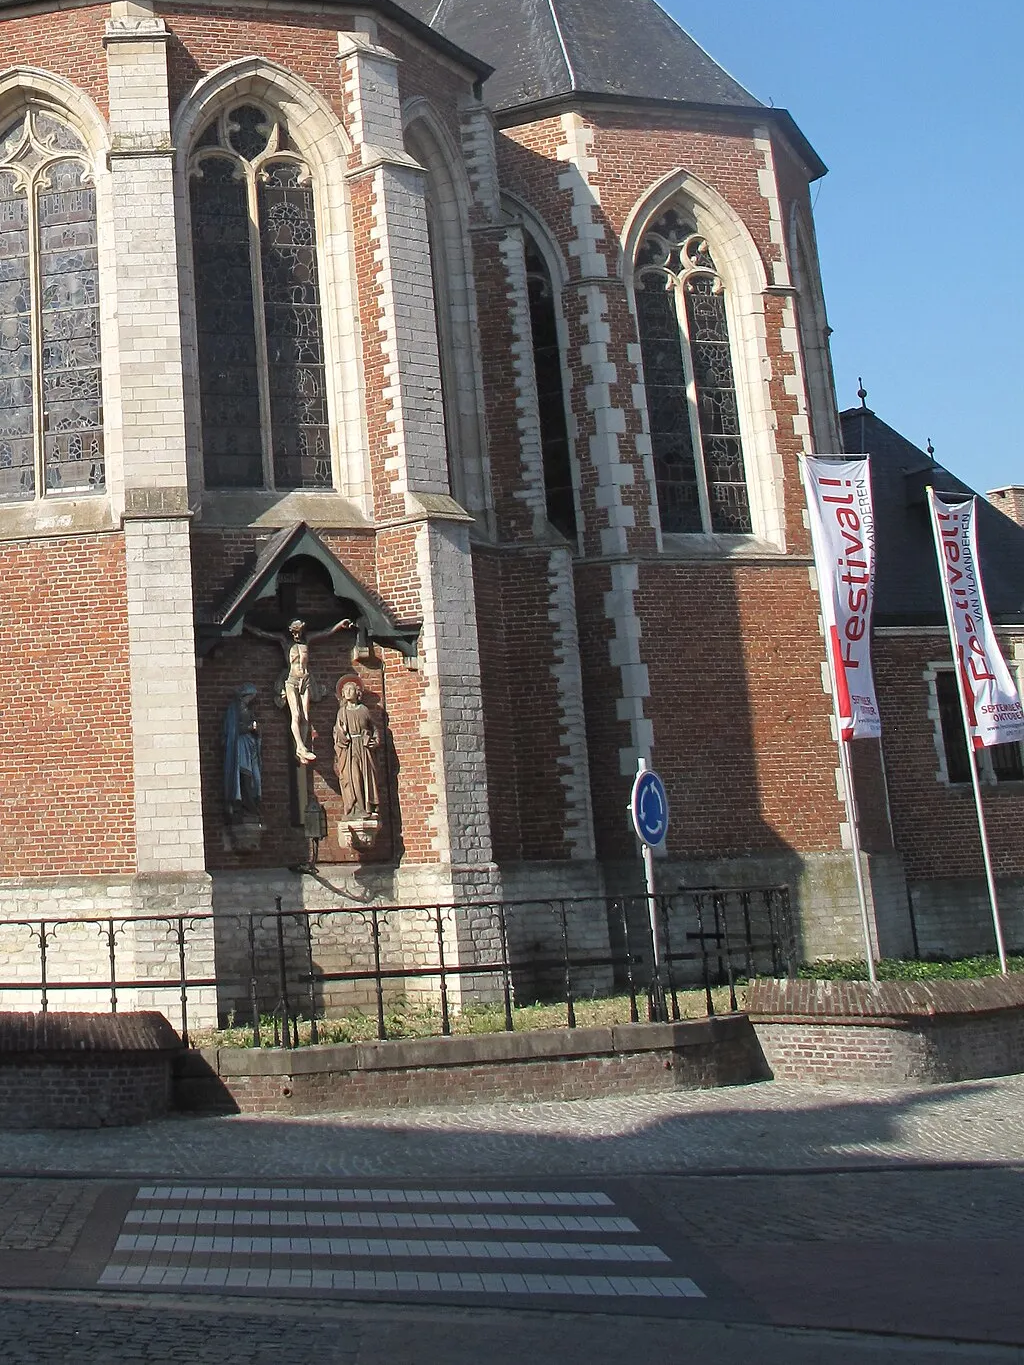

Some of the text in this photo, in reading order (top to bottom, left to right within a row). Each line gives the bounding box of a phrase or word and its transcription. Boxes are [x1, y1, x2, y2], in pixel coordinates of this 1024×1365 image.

[818, 478, 870, 668] Festival!
[961, 514, 984, 622] VAN VLAANDEREN
